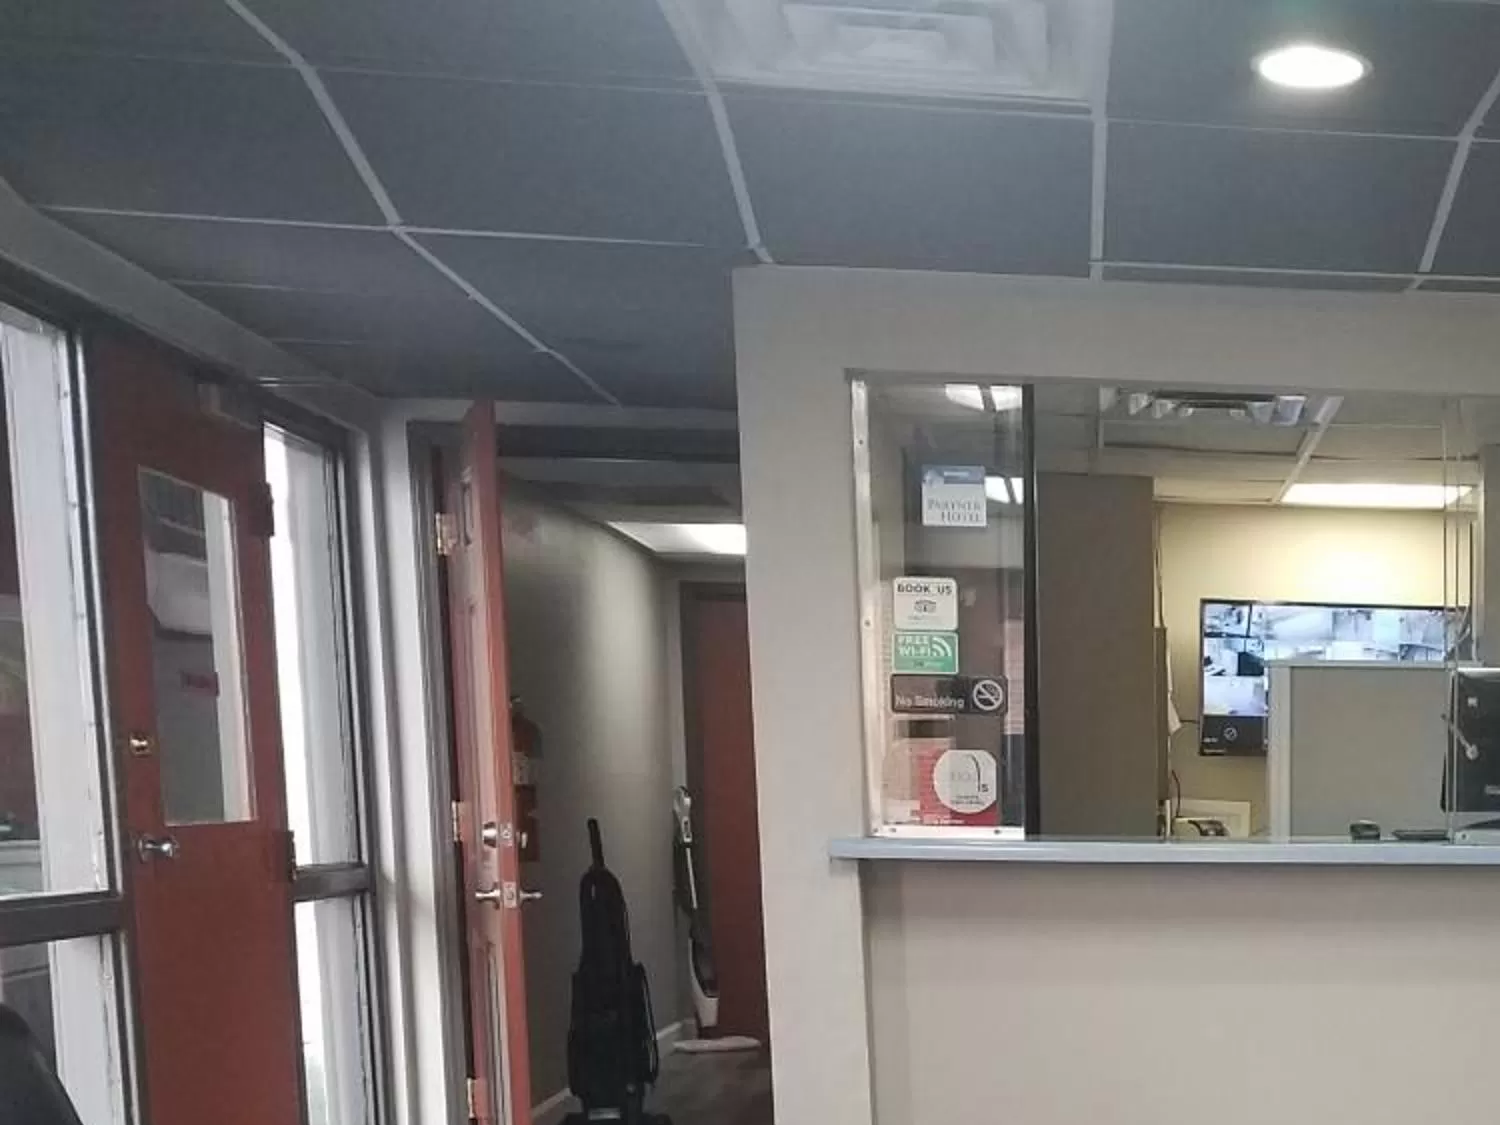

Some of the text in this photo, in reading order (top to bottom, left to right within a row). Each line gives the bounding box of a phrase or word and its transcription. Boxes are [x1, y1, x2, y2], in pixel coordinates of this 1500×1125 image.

[941, 511, 983, 522] HOTEL
[897, 583, 953, 595] BOOK US
[898, 635, 929, 645] FREE
[894, 695, 965, 709] No Smoking
